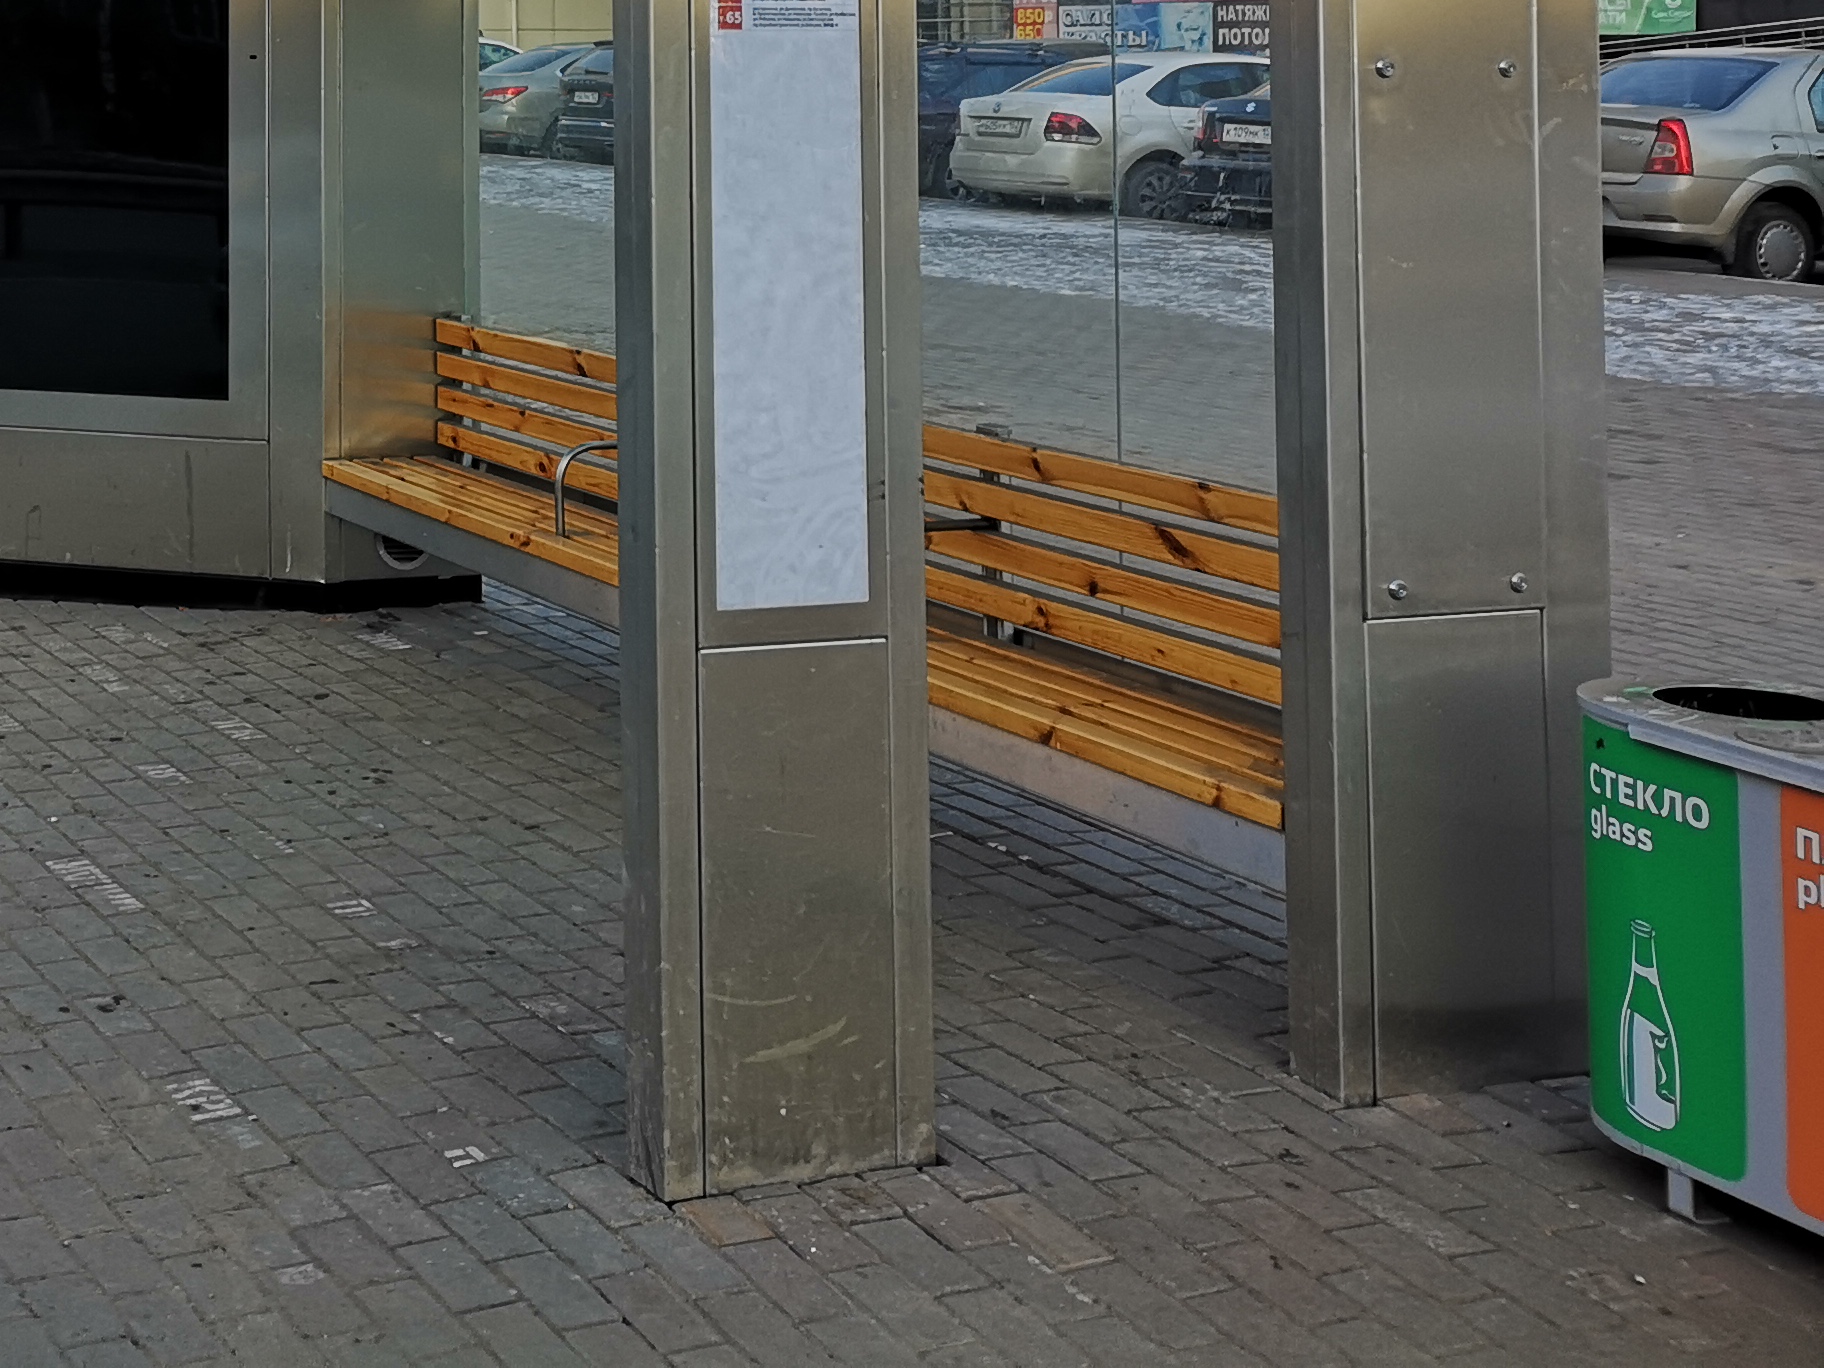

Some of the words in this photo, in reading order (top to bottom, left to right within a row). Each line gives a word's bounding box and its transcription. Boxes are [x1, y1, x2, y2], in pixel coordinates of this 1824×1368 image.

[1217, 5, 1269, 22] НАТЯЖ
[1589, 762, 1710, 830] СТЕКЛО
[1590, 804, 1654, 852] glass
